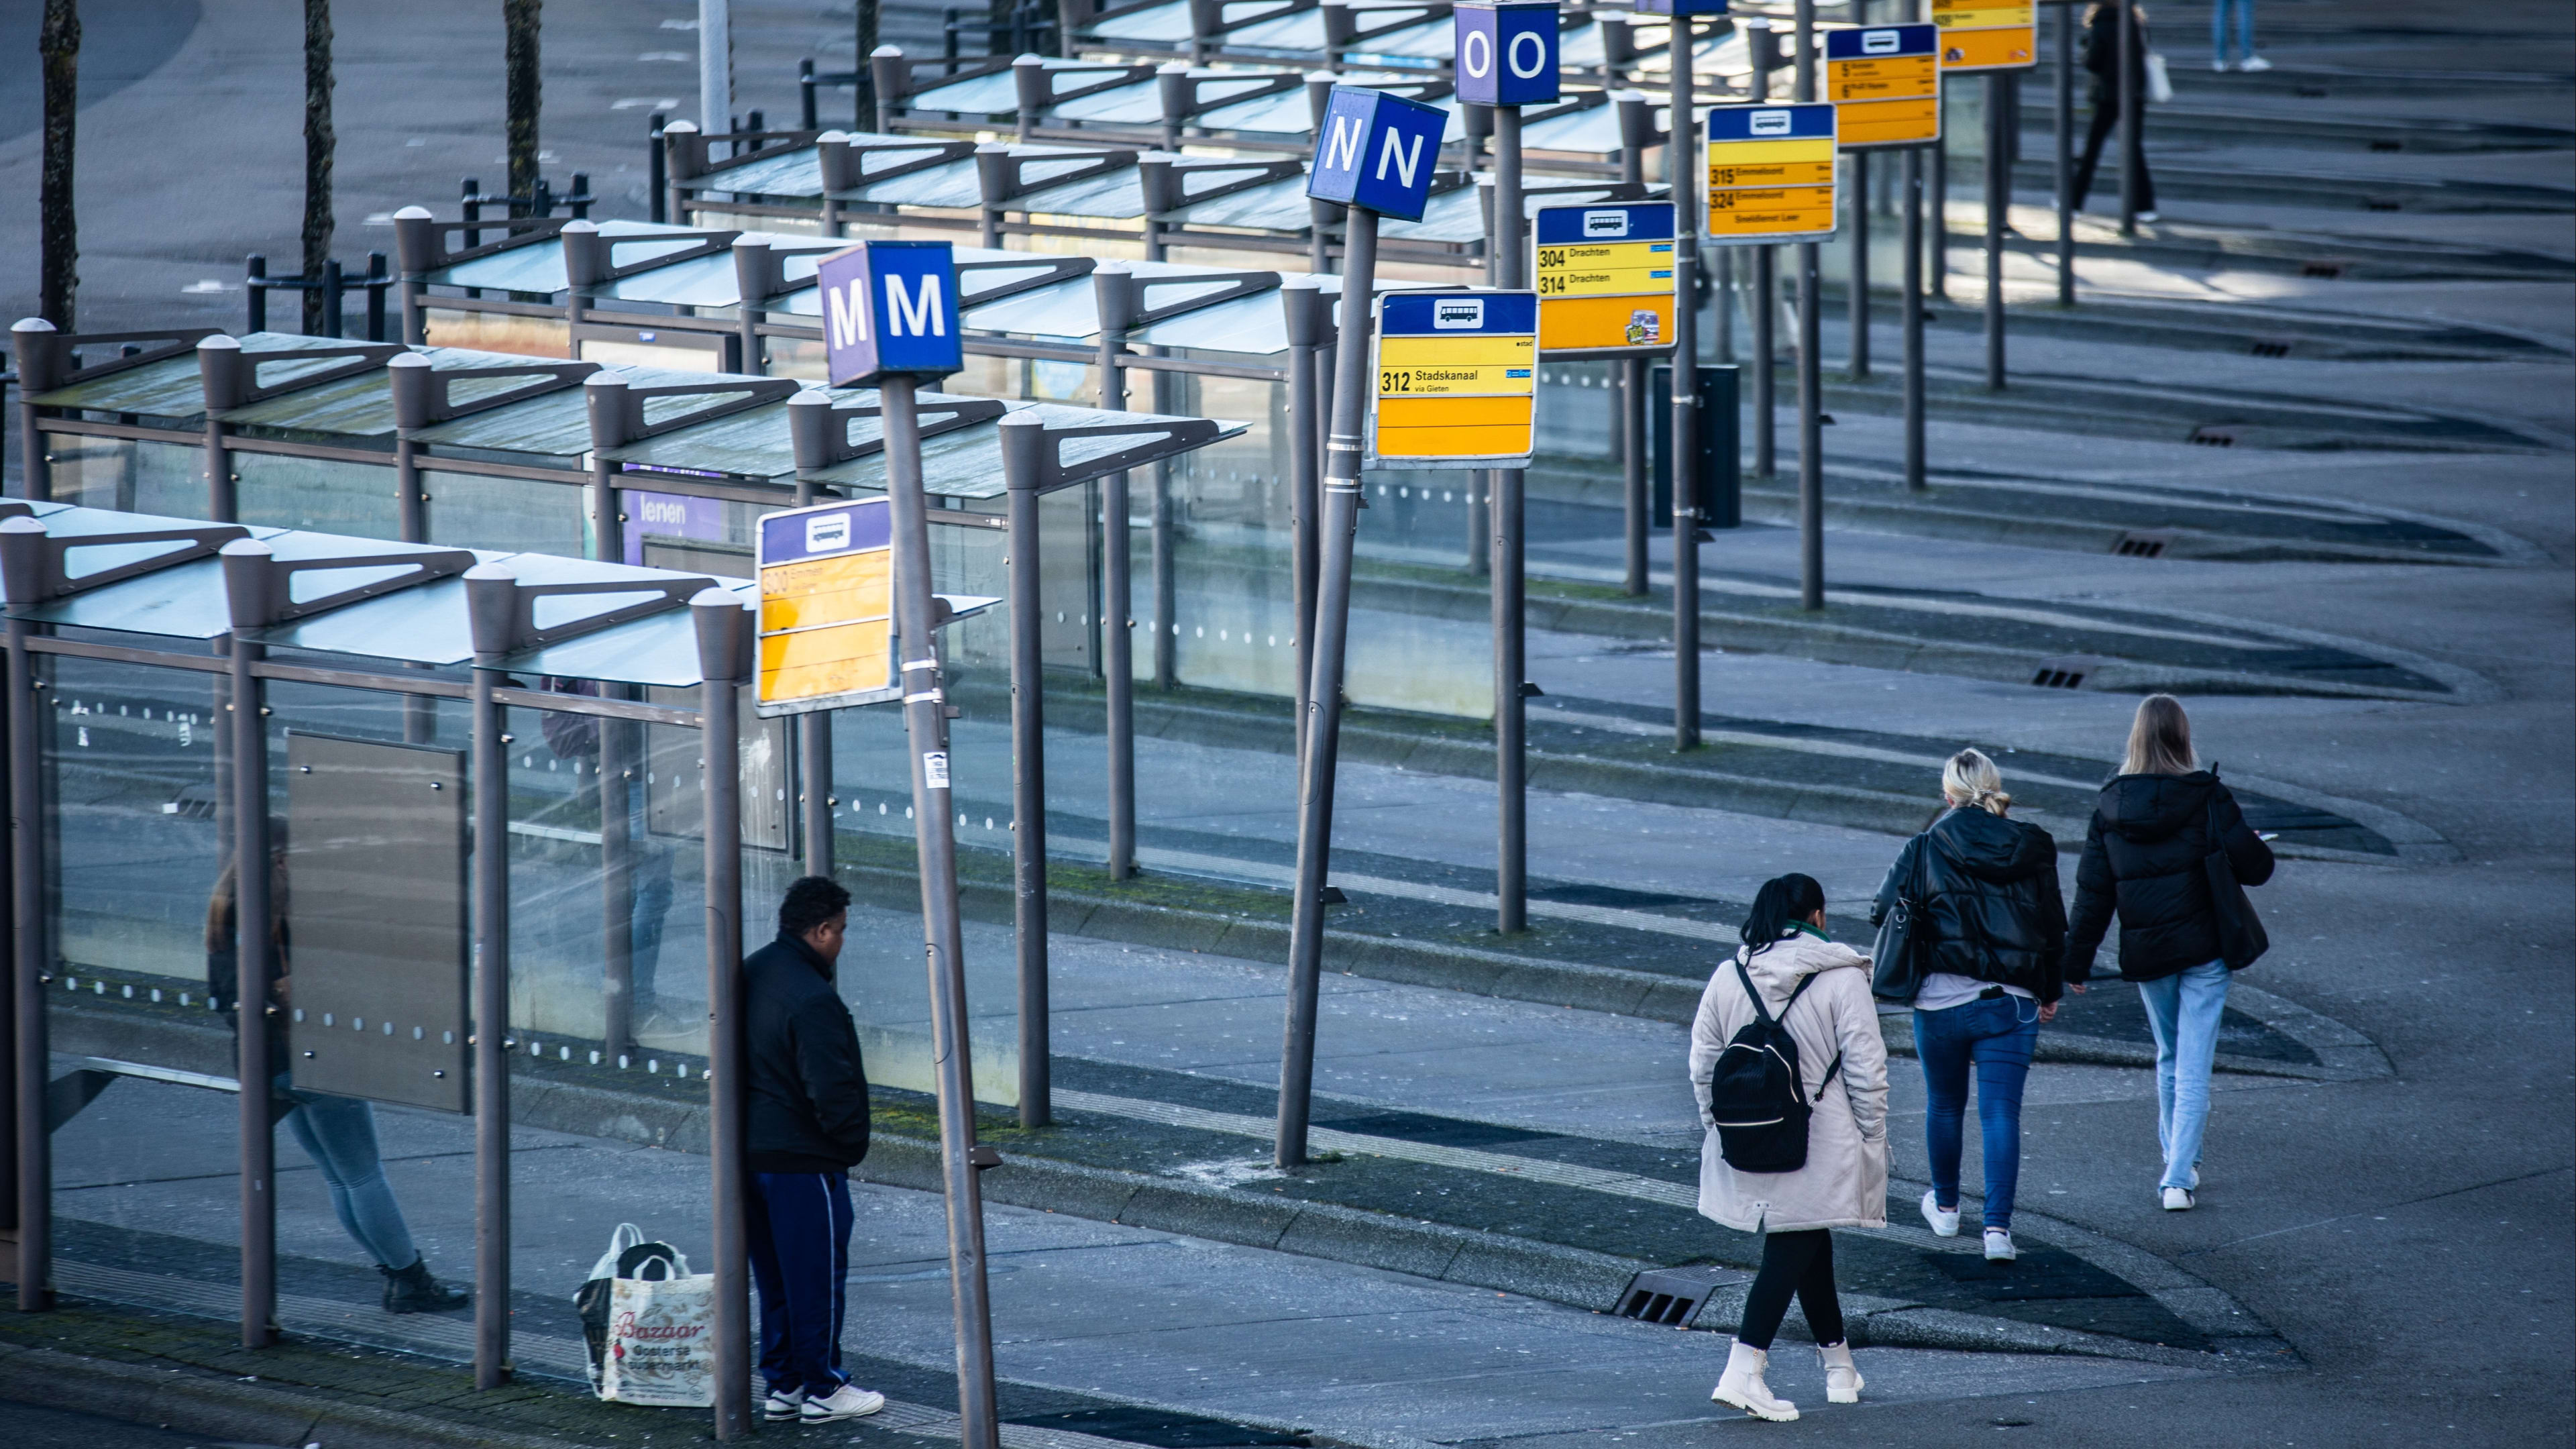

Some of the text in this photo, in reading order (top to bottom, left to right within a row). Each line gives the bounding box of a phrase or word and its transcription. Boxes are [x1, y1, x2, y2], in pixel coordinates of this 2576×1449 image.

[1325, 116, 1362, 171] N
[1376, 127, 1424, 189] N
[1711, 169, 1735, 184] 315
[1710, 193, 1735, 209] 324
[1540, 248, 1610, 268] 304 Drachten
[1540, 274, 1610, 294] 314 Drachten
[829, 278, 867, 350] M
[884, 274, 946, 337] M
[1382, 370, 1478, 392] 312 Stadskanaal
[612, 1311, 706, 1340] Bazaar
[633, 1344, 691, 1356] Oosterse
